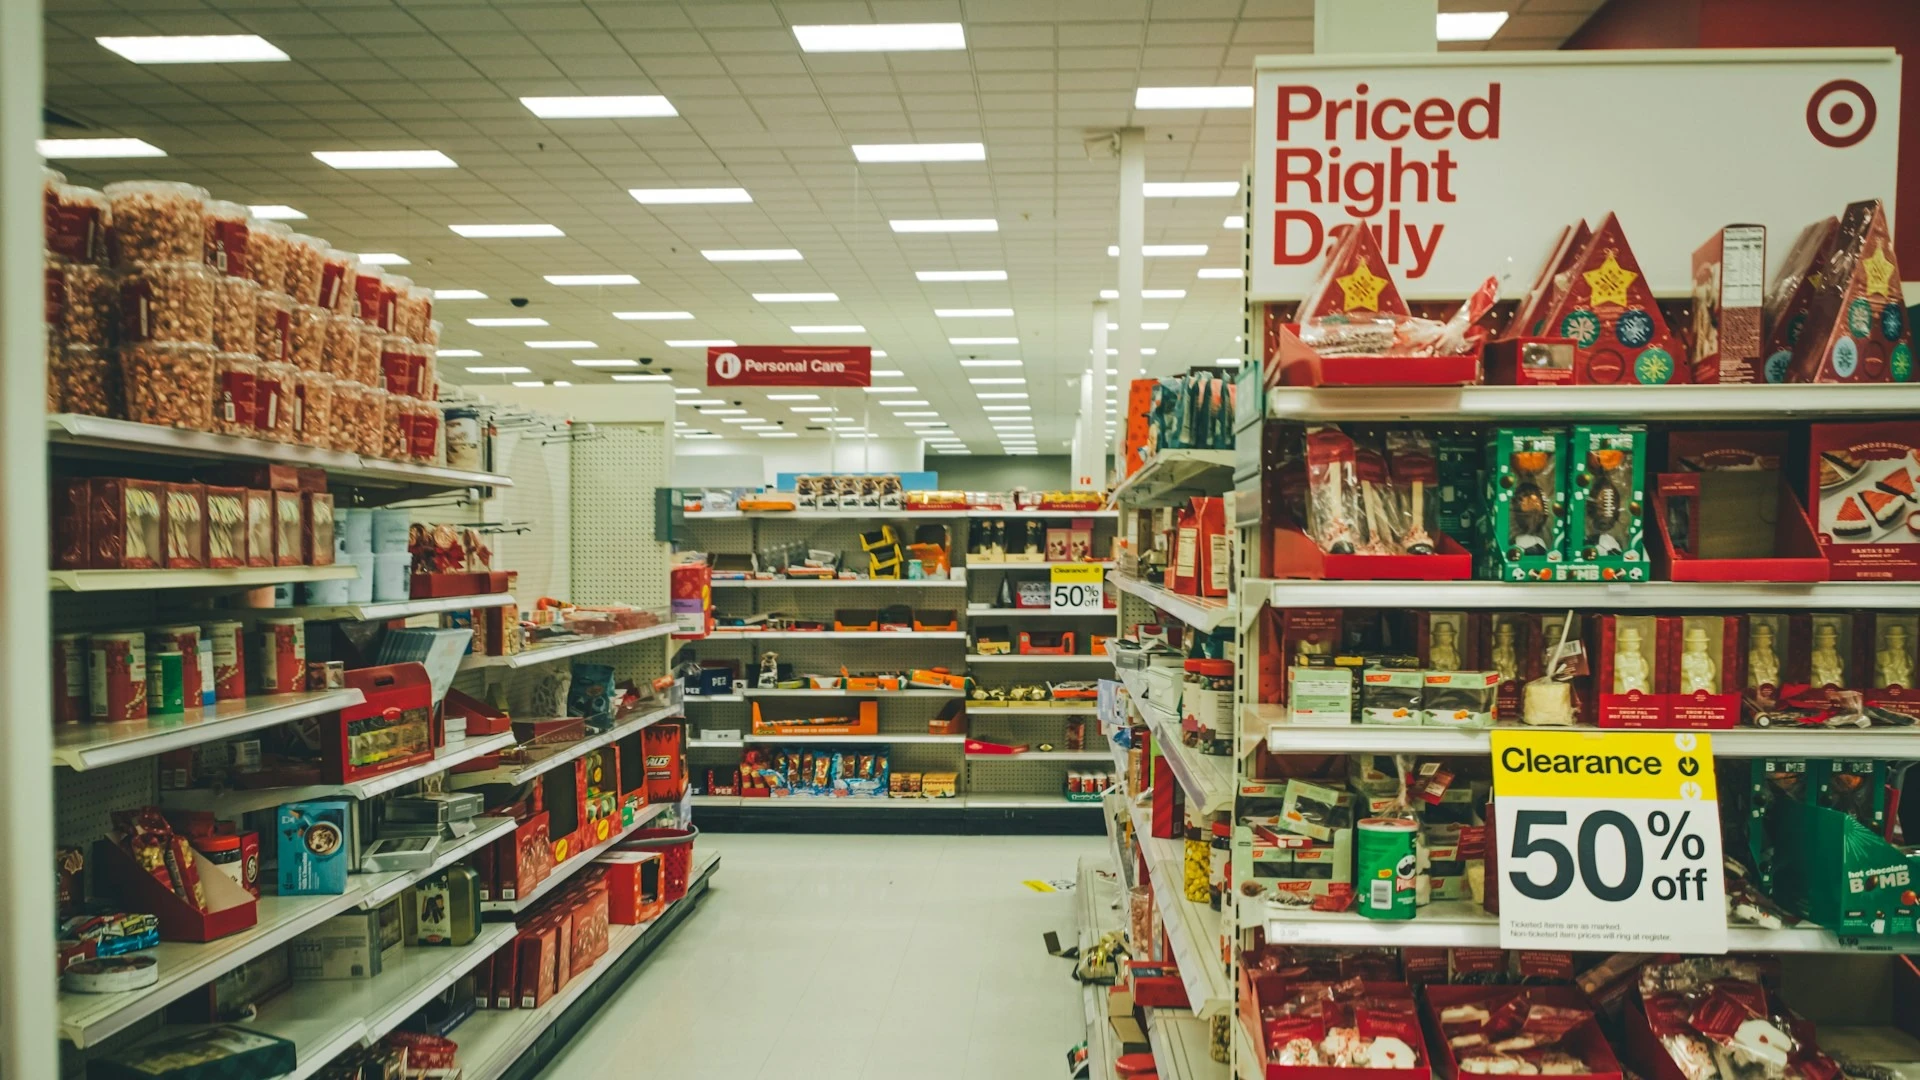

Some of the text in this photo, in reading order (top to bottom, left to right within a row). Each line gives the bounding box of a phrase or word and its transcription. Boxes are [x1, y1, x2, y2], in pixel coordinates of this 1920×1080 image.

[1276, 83, 1501, 141] Priced
[1275, 146, 1458, 218] Right
[744, 358, 845, 373] Personal Care
[1085, 598, 1098, 607] off
[711, 676, 727, 687] PEZ
[1501, 747, 1662, 775] Clearance
[715, 787, 733, 795] PEZ
[1848, 864, 1908, 879] hot chocolate
[1652, 868, 1707, 901] off
[1510, 920, 1542, 929] Ticketed
[1543, 921, 1564, 929] items
[1510, 929, 1672, 942] Non-ticketed item prices will ring at register.
